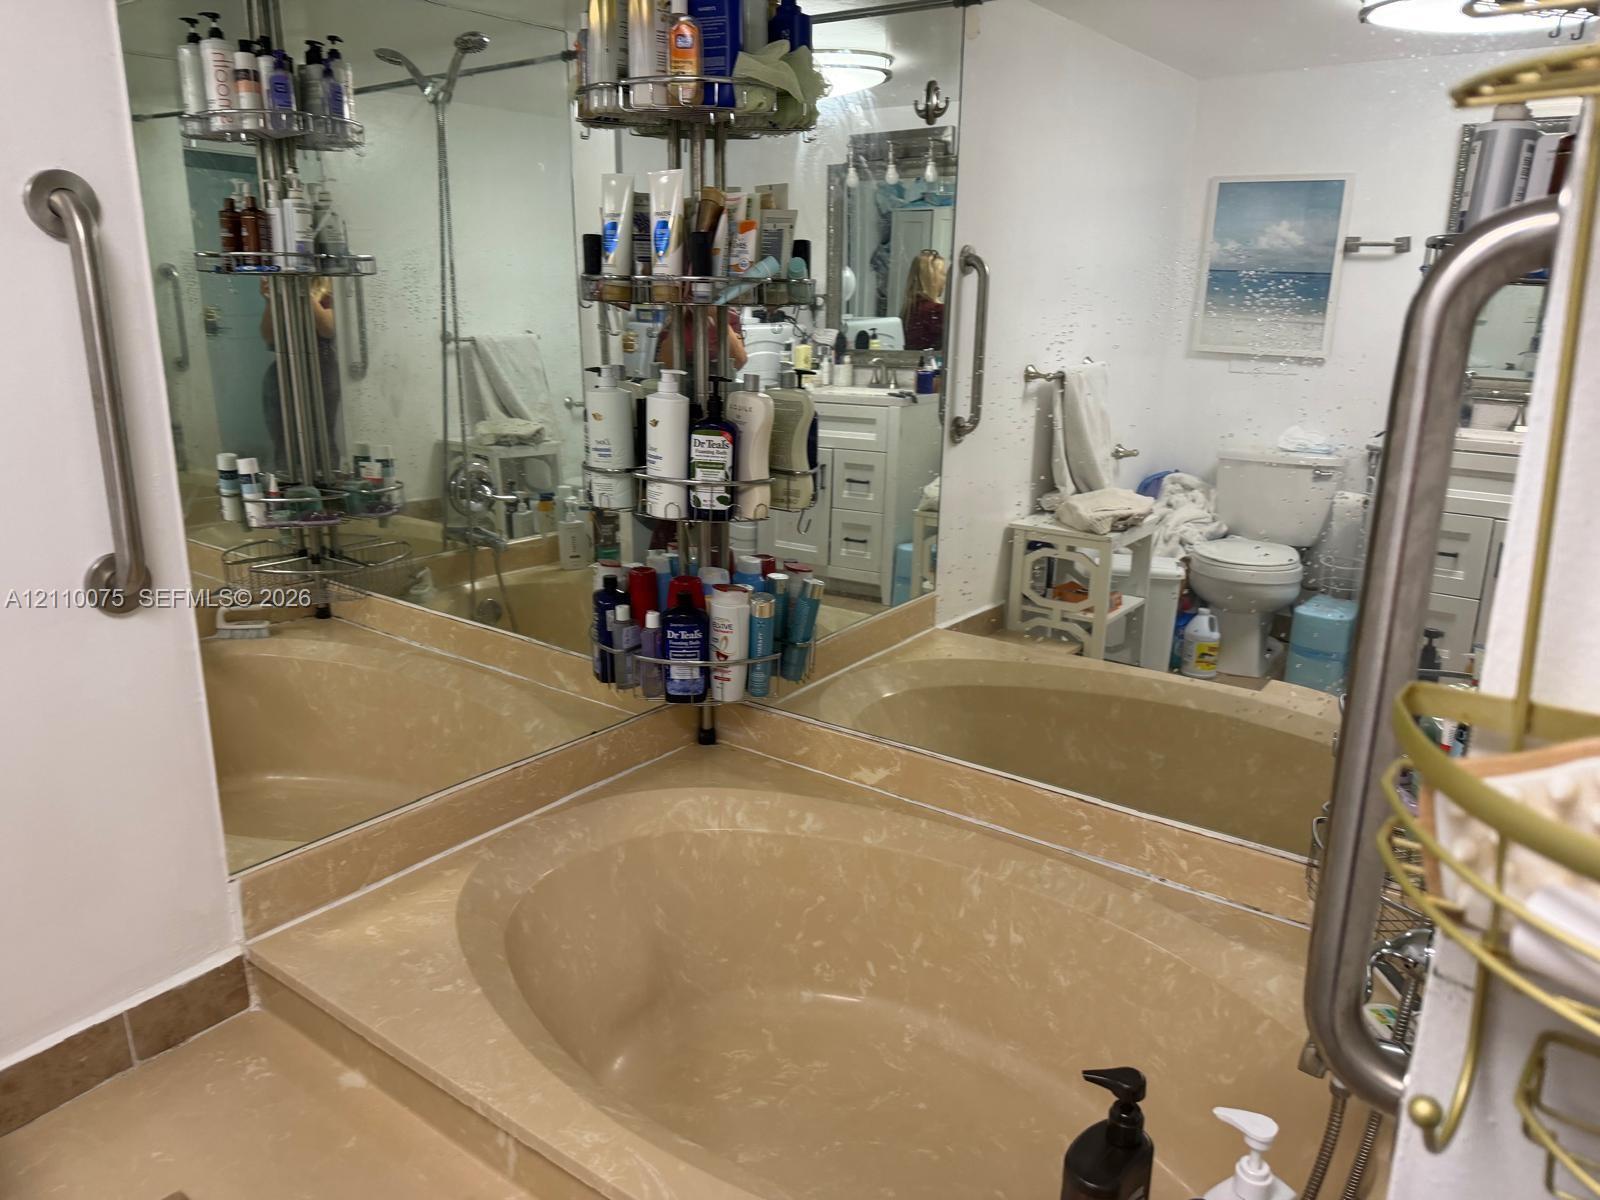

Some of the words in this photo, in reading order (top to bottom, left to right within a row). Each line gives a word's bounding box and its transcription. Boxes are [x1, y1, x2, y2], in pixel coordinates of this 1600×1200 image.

[694, 438, 706, 448] Dr
[706, 439, 730, 449] Teal's
[666, 630, 679, 639] Dr
[678, 629, 703, 639] Teal's
